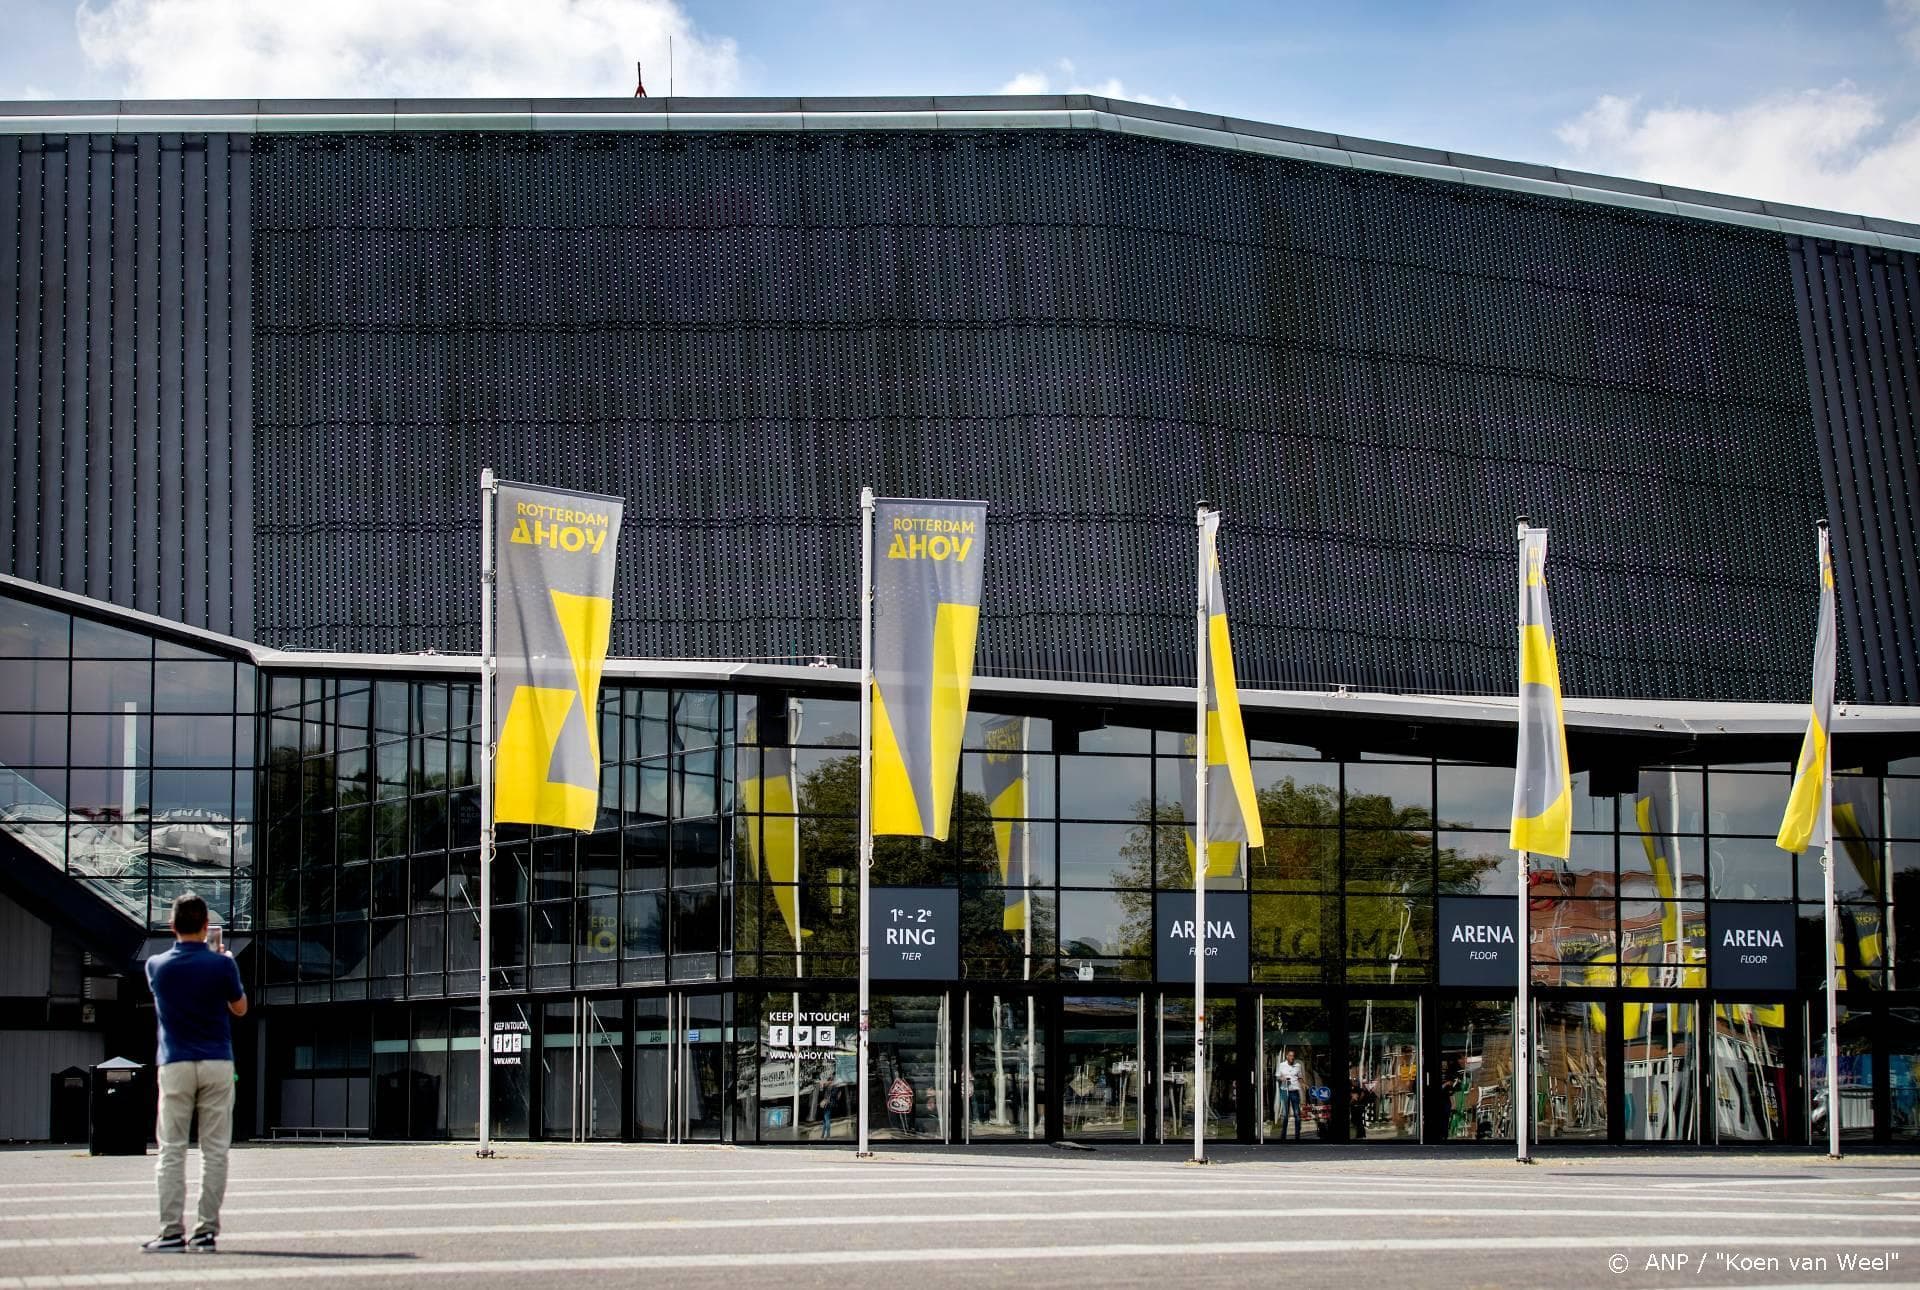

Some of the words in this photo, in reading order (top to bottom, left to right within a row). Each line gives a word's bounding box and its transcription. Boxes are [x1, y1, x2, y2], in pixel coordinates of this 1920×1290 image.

[517, 502, 609, 528] ROTTERDAM
[893, 518, 975, 534] ROTTERDAM
[511, 518, 607, 554] AHOY
[888, 533, 973, 561] AHOY
[886, 928, 936, 946] RING
[1170, 920, 1236, 939] ARNA
[1451, 925, 1514, 943] ARENA
[1723, 929, 1784, 947] ARENA
[902, 952, 922, 961] TIER
[1189, 947, 1218, 956] FOR
[1470, 951, 1498, 960] FLOOR
[1741, 955, 1768, 964] FLOOR
[769, 1012, 794, 1022] KEEP
[809, 1012, 850, 1022] TOUCH!
